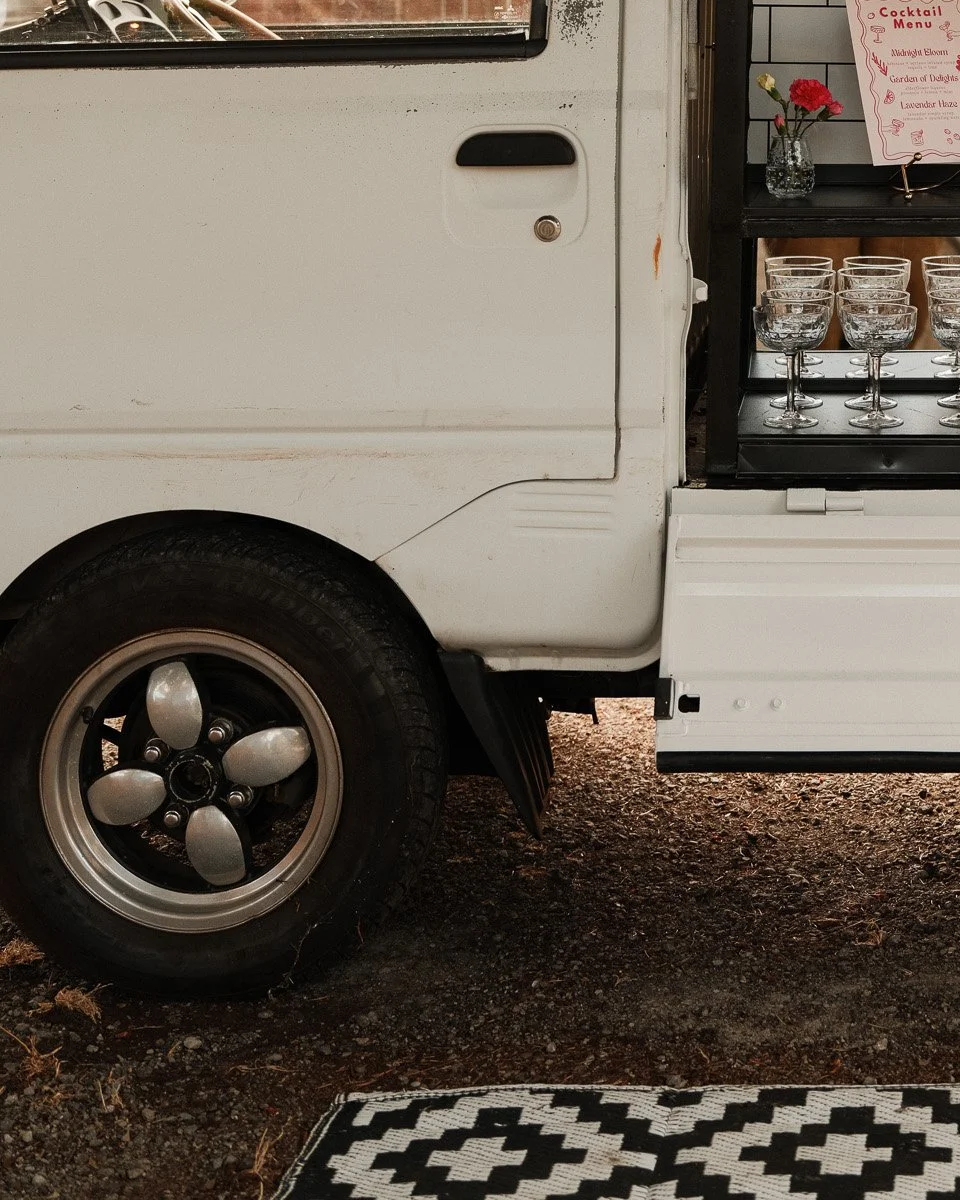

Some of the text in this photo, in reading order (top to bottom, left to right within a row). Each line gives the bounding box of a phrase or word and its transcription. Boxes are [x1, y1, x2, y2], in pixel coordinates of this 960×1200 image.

[879, 5, 942, 17] Cocktail
[893, 18, 932, 29] Menu
[891, 48, 949, 59] Midnight Bloom
[889, 73, 959, 84] Garden of Delights
[938, 99, 958, 108] Haze
